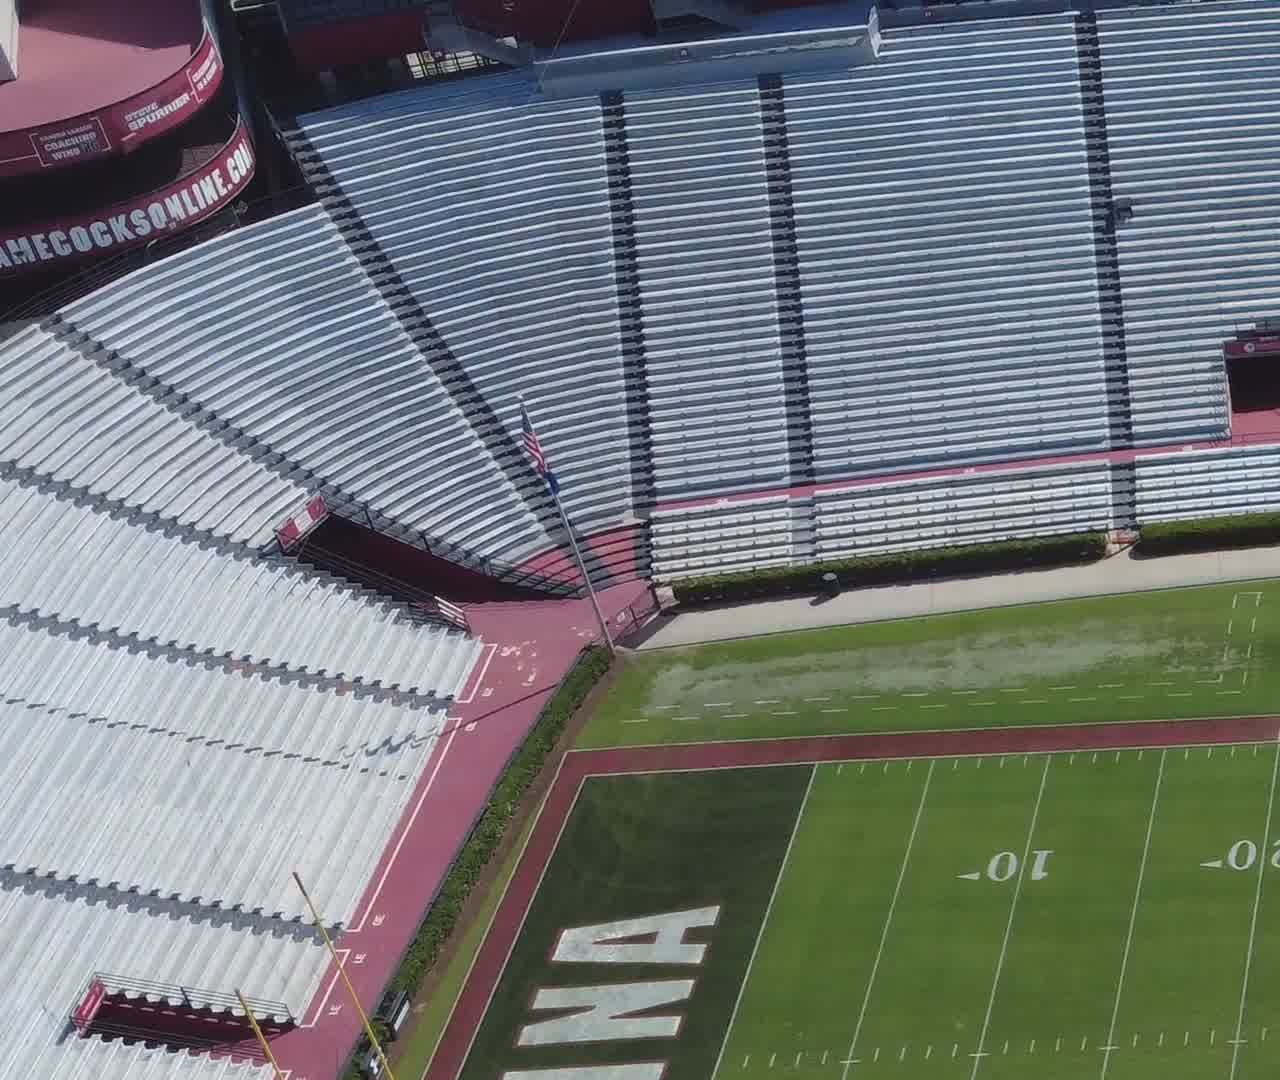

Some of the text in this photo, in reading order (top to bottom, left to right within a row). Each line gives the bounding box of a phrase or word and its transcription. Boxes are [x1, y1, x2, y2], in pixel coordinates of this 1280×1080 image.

[124, 102, 159, 122] STEVE
[127, 92, 192, 131] SPURRIER
[0, 138, 253, 268] AMECOCKSONLINE.COM
[987, 848, 1051, 882] 10
